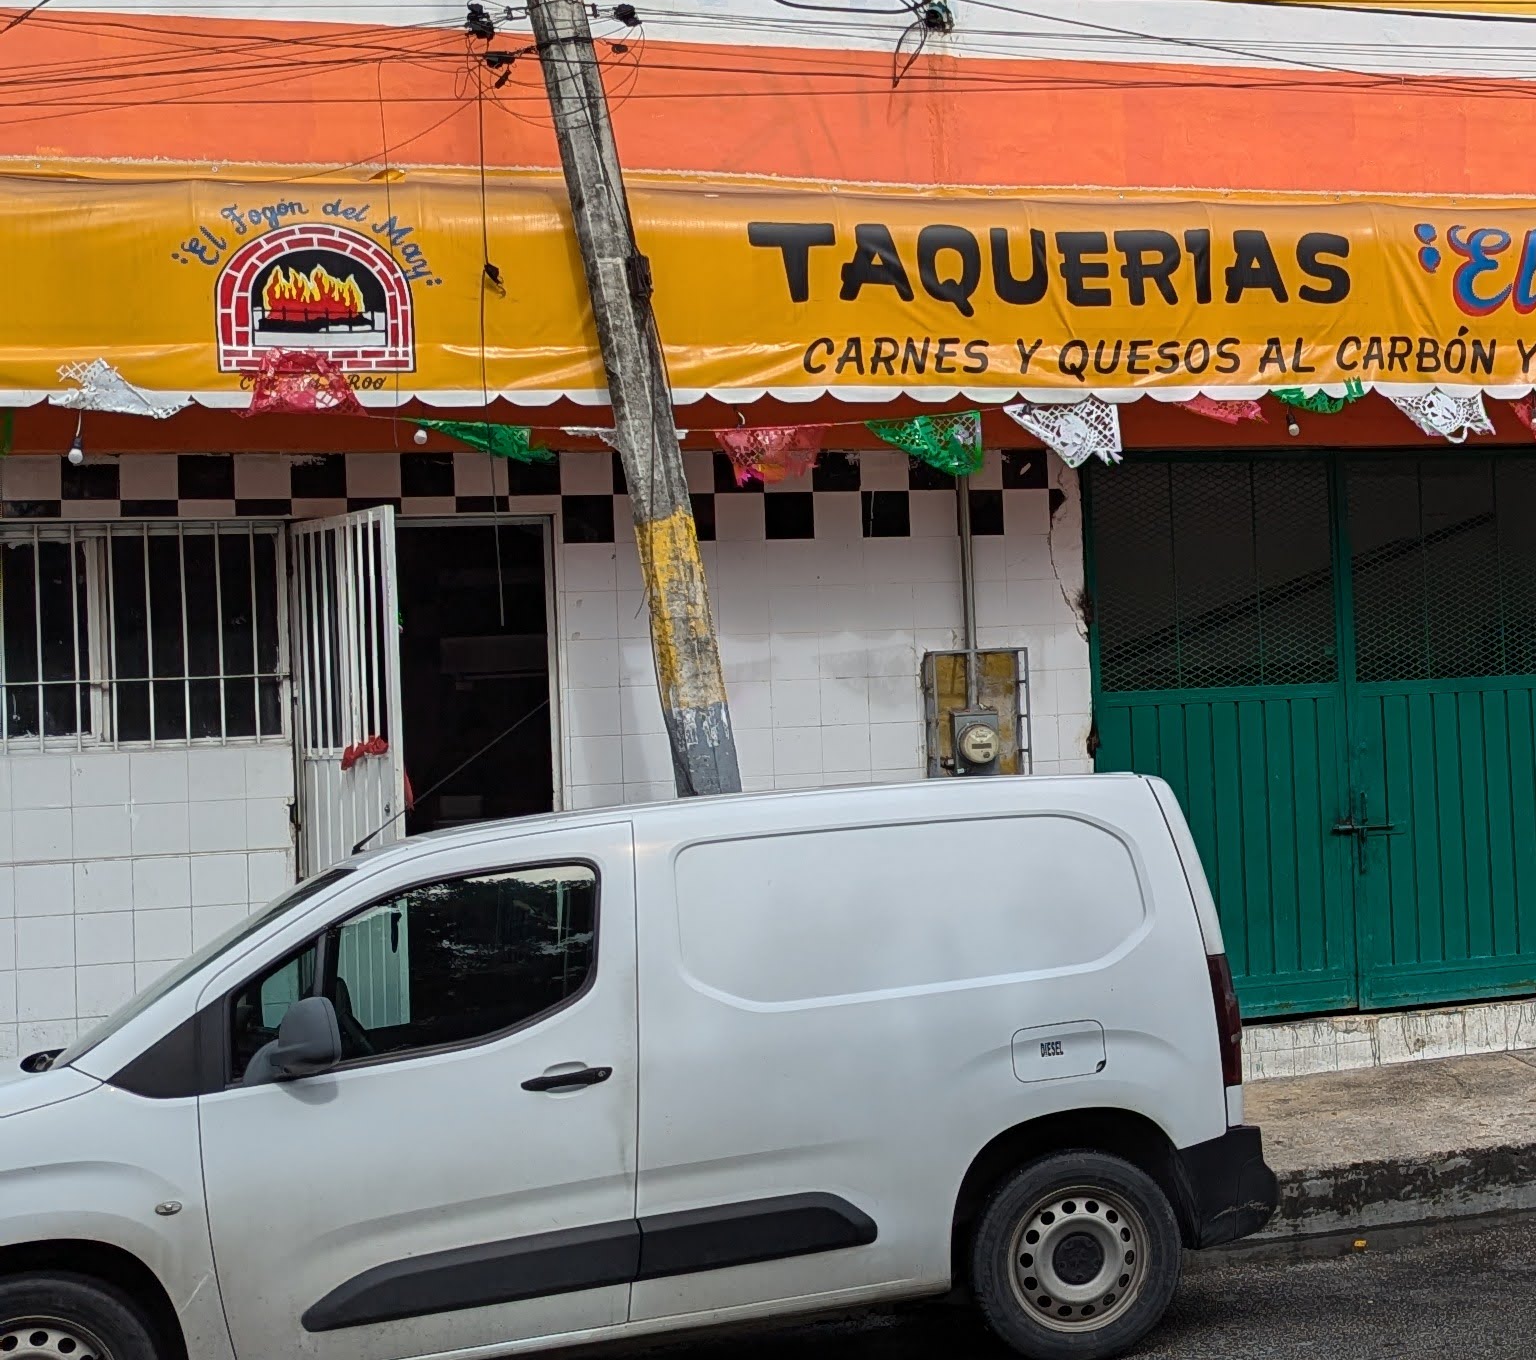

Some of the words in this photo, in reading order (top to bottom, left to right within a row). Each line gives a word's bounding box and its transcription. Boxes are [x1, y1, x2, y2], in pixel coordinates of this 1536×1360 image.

[322, 199, 370, 223] del
[748, 222, 1351, 317] TAQUERIAS
[803, 336, 989, 375] CARNES
[1017, 338, 1043, 373] Y
[1058, 337, 1241, 382] QUESOS
[1258, 338, 1316, 373] AL
[1336, 326, 1496, 375] CARBÓN
[1040, 1040, 1064, 1057] DIESEL
